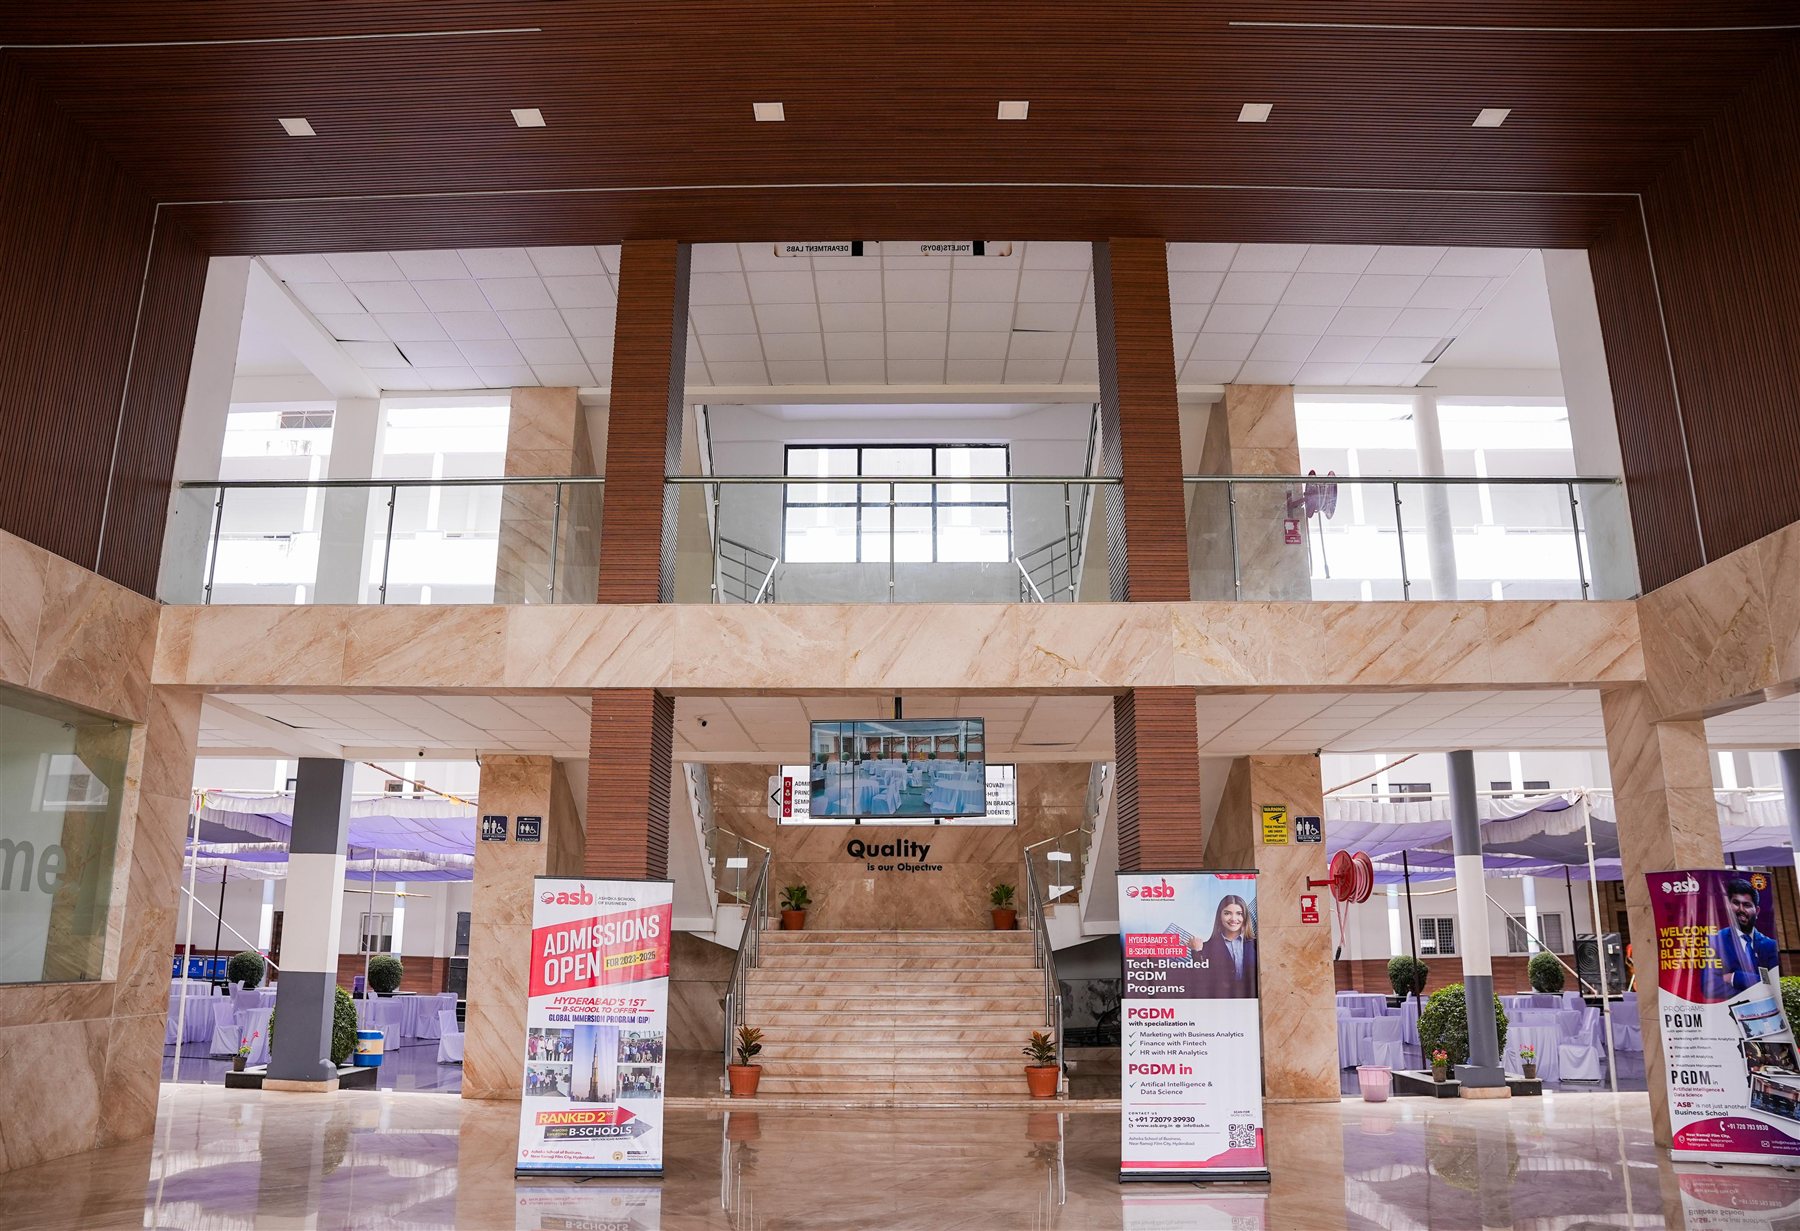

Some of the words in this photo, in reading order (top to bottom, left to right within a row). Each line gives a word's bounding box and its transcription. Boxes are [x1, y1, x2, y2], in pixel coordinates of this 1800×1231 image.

[846, 839, 930, 862] Quality
[867, 863, 875, 871] is
[897, 863, 942, 872] Objective
[1140, 881, 1175, 898] asb
[1673, 877, 1700, 893] asb
[556, 884, 594, 906] asb
[544, 915, 660, 957] ADMISSIONS
[1660, 926, 1718, 938] WELCOME
[1660, 938, 1674, 948] TO
[1679, 937, 1709, 947] TECH
[1660, 948, 1715, 959] BLENDED
[544, 950, 600, 986] OPEN
[606, 958, 619, 967] FOR
[1126, 959, 1210, 969] Tech-Blended
[1661, 959, 1722, 970] INSTITUTE
[1127, 971, 1166, 980] PGDM
[1127, 983, 1185, 995] Programs
[554, 997, 626, 1006] HYDERABAD'S
[548, 1014, 570, 1022] GLOBAL
[606, 1015, 636, 1023] PROGRAM
[1128, 1008, 1175, 1019] PGDM
[1665, 1014, 1702, 1028] PGDM
[1128, 1064, 1175, 1075] PGDM
[1179, 1064, 1192, 1075] in
[1671, 1070, 1711, 1085] PGDM
[539, 1112, 596, 1124] RANKED
[569, 1126, 632, 1136] B-SCHOOLS
